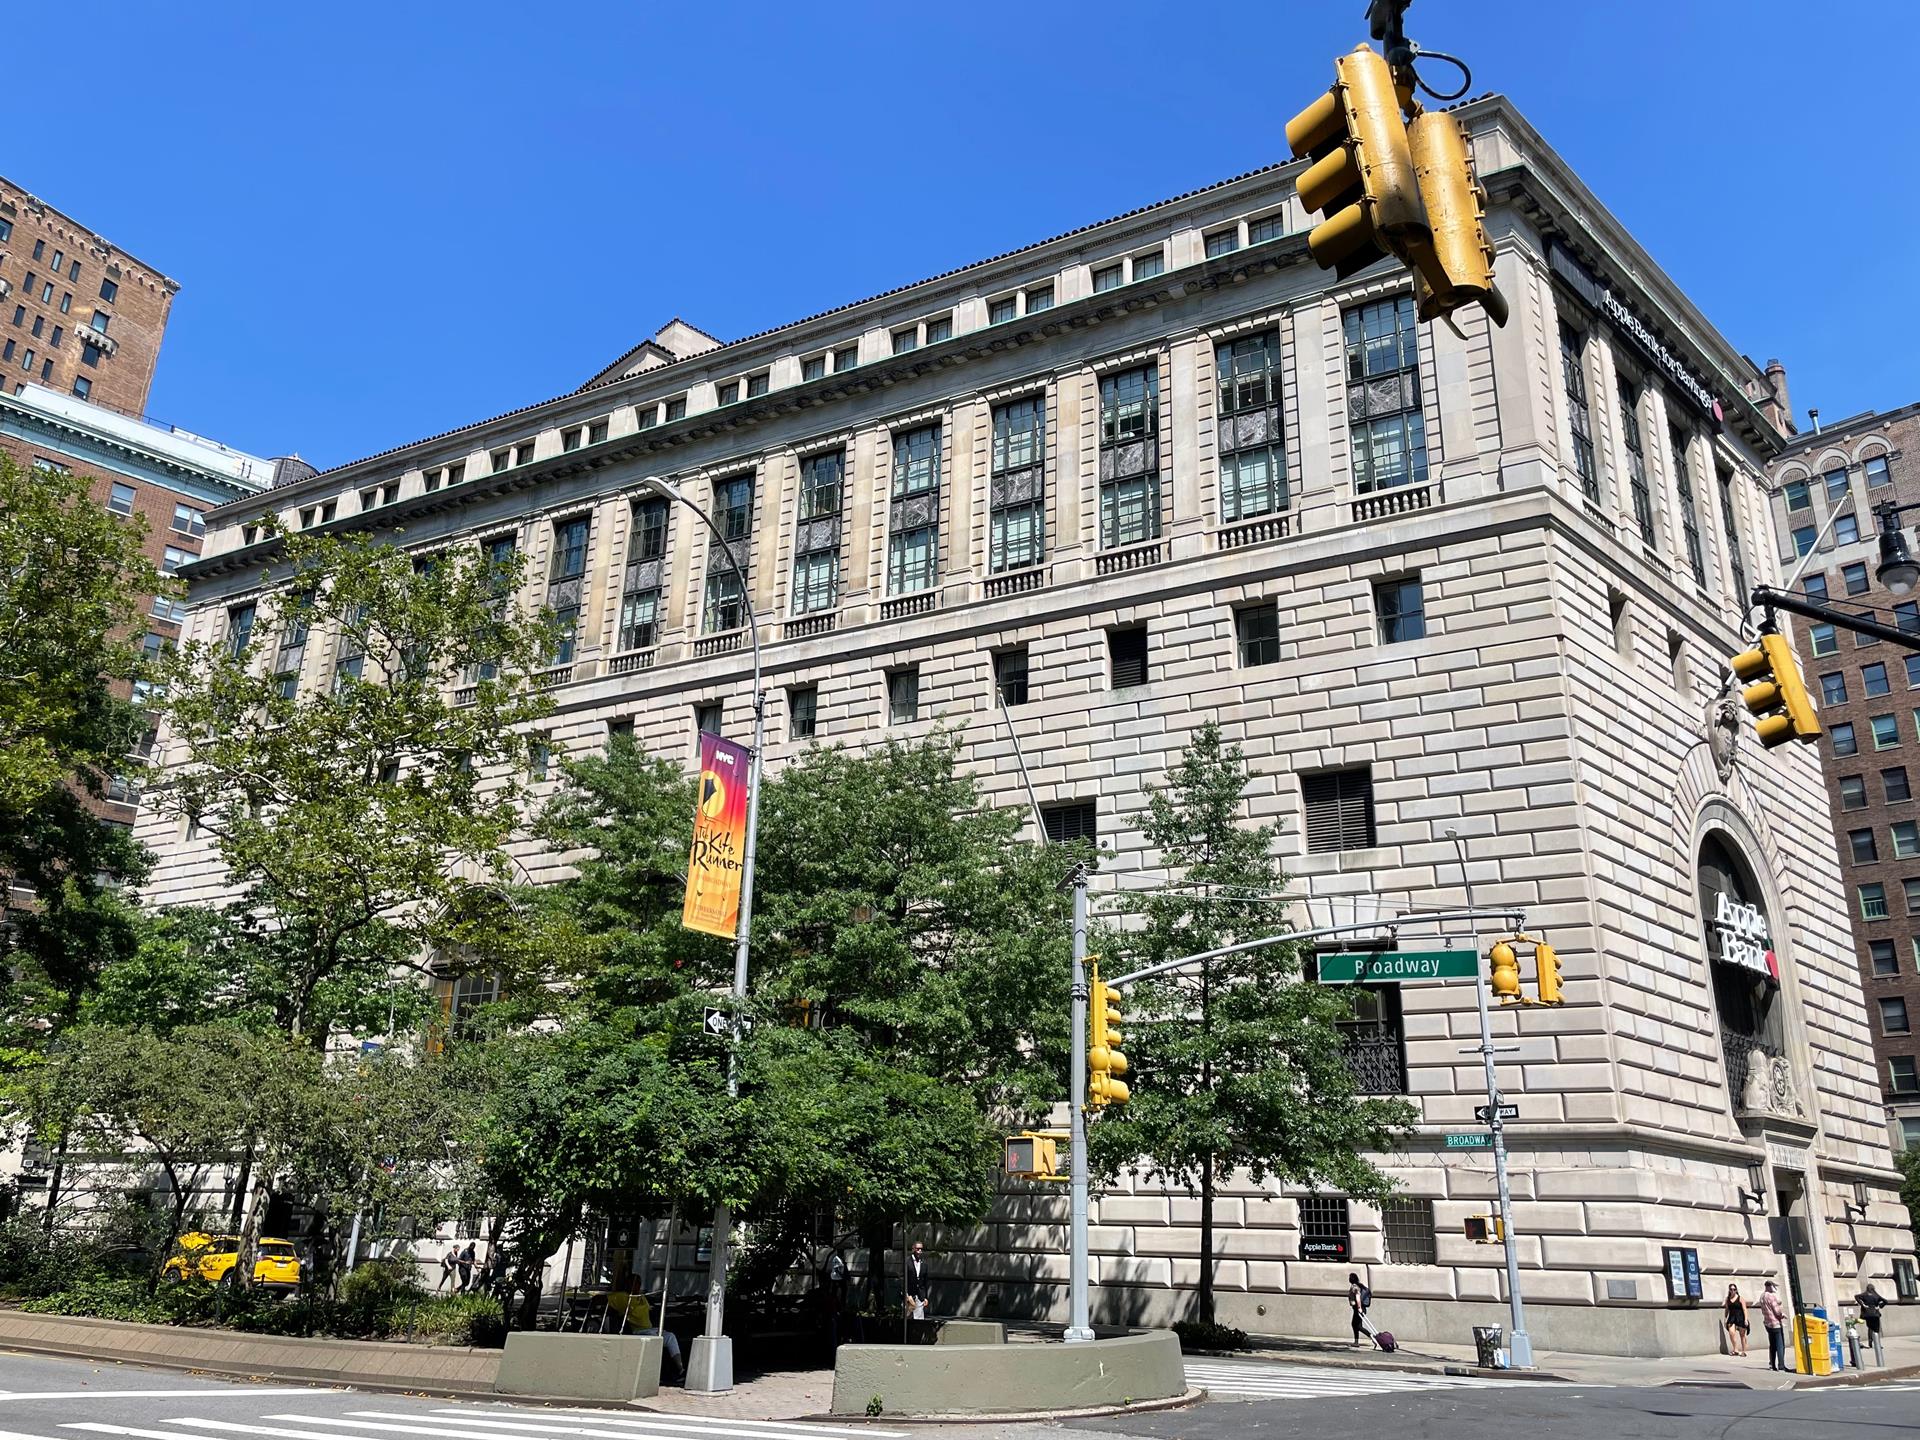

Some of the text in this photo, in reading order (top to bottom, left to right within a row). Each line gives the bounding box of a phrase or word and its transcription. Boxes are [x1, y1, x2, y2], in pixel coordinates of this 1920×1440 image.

[1602, 289, 1713, 409] Apple Bank for Savings
[715, 750, 734, 765] NYC
[692, 831, 743, 872] Runner
[709, 828, 735, 855] Kite
[1714, 891, 1768, 940] Apple
[1355, 957, 1440, 976] Broadway
[1716, 927, 1772, 976] Bank
[1304, 1243, 1321, 1251] Apple
